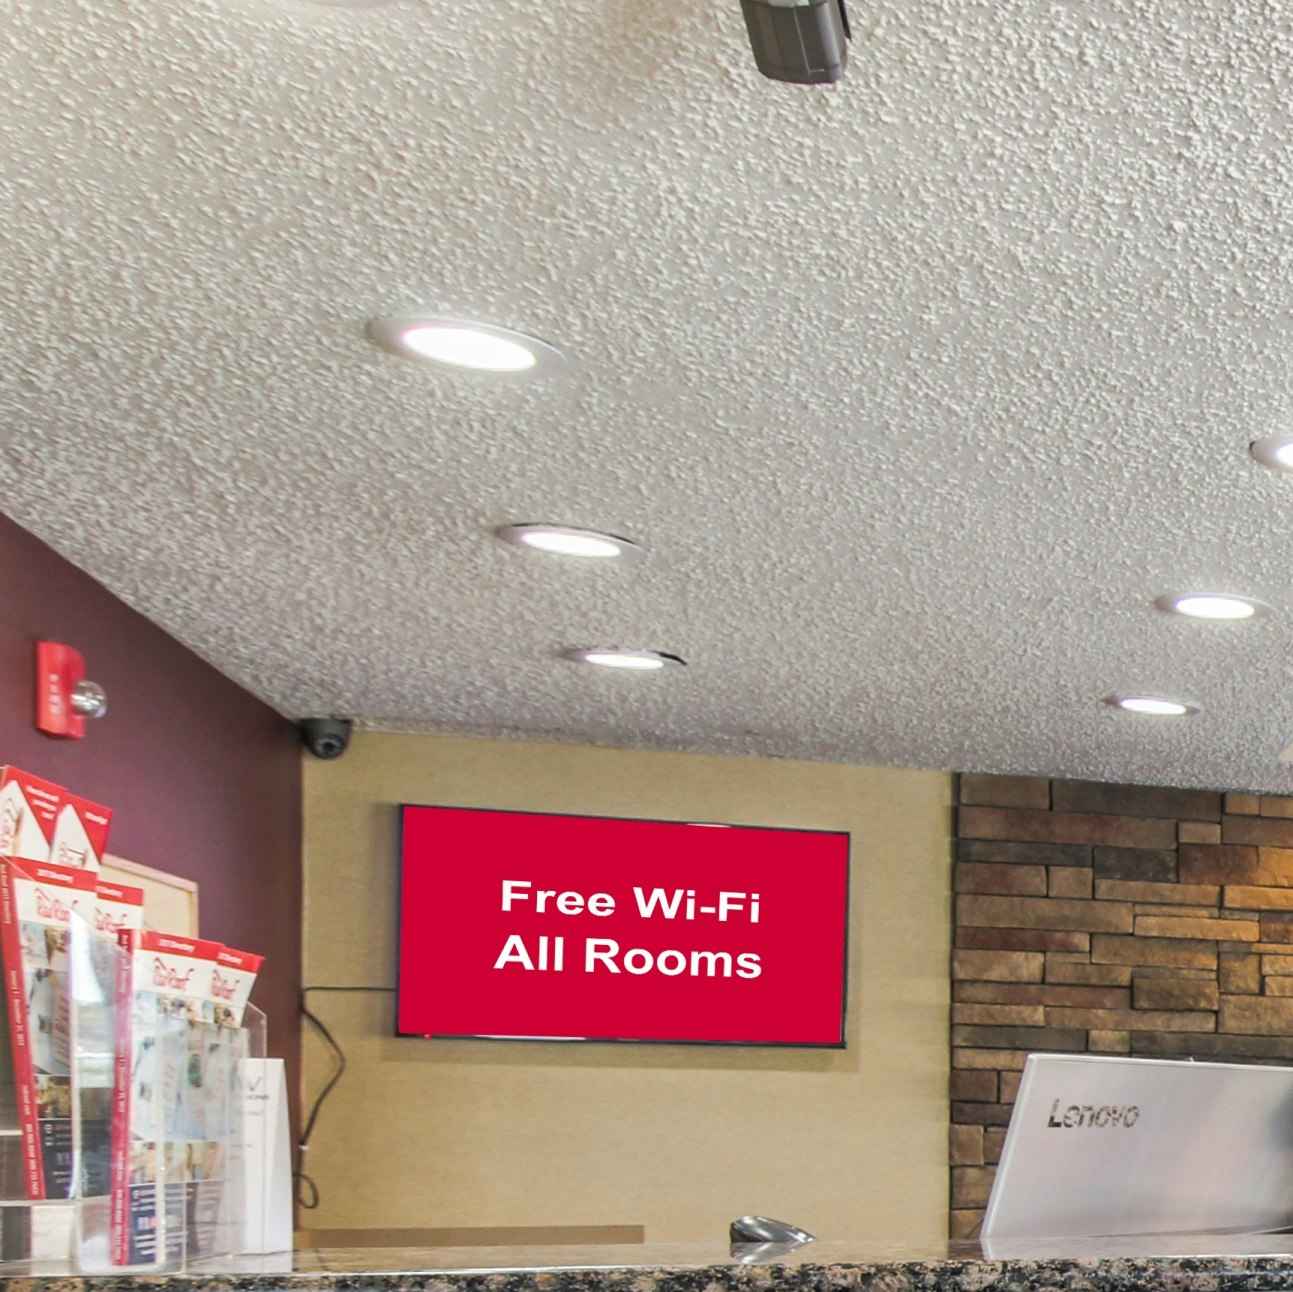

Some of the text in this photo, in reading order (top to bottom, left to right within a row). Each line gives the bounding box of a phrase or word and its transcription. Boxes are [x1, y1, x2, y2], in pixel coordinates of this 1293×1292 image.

[501, 879, 761, 923] Free Wi-Fi
[493, 934, 762, 979] All Rooms
[1047, 1098, 1140, 1129] Lenovo
